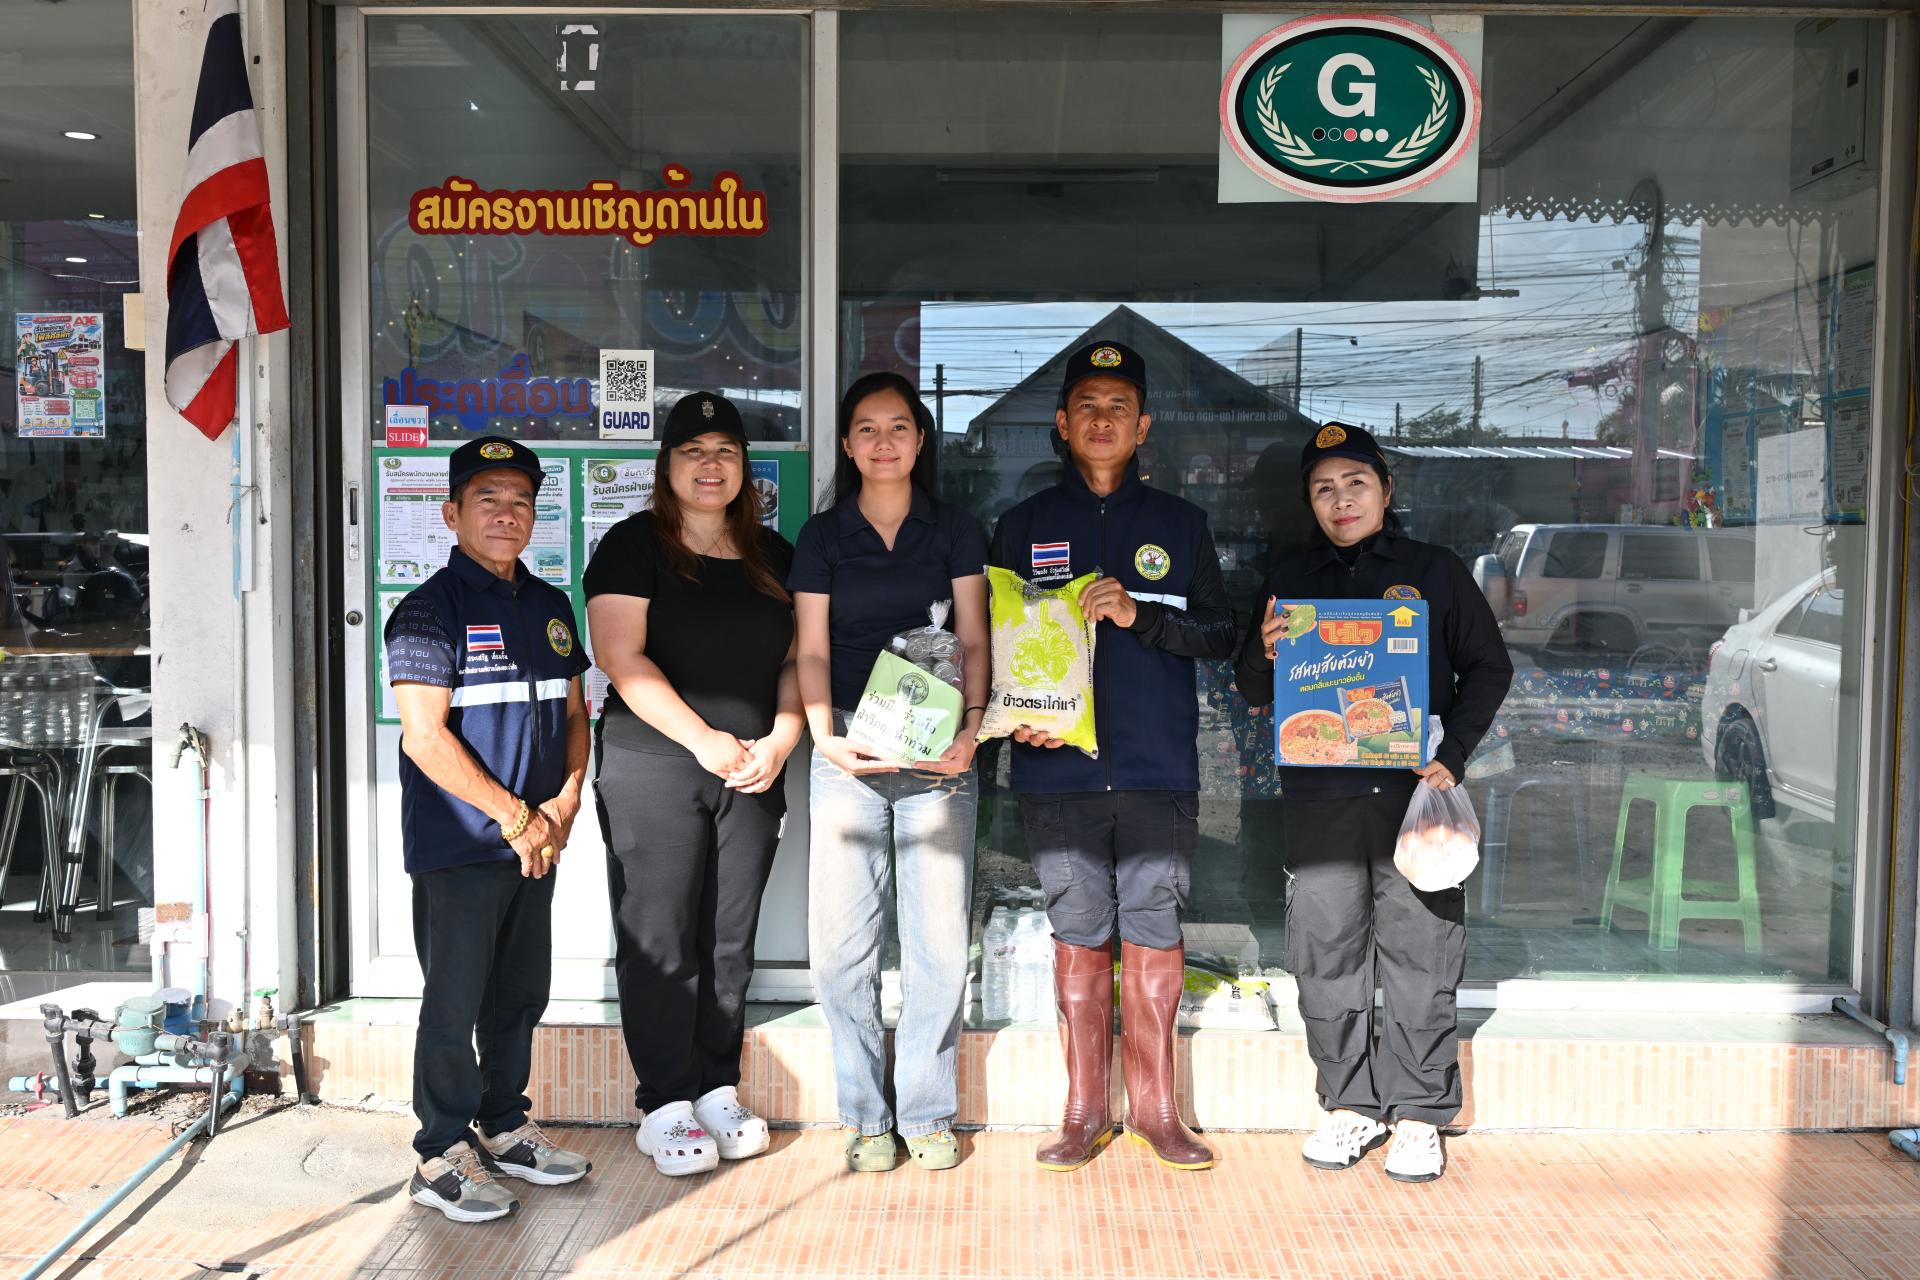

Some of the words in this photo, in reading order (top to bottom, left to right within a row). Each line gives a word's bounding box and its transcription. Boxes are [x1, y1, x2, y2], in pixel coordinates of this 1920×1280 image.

[1317, 52, 1376, 118] G
[602, 411, 650, 429] GUARD
[388, 432, 420, 442] SLIDE
[592, 482, 655, 496] รับสมัครฝ่ายผ
[409, 649, 430, 658] you
[1003, 693, 1077, 711] ข้าวตราไก่แจ้
